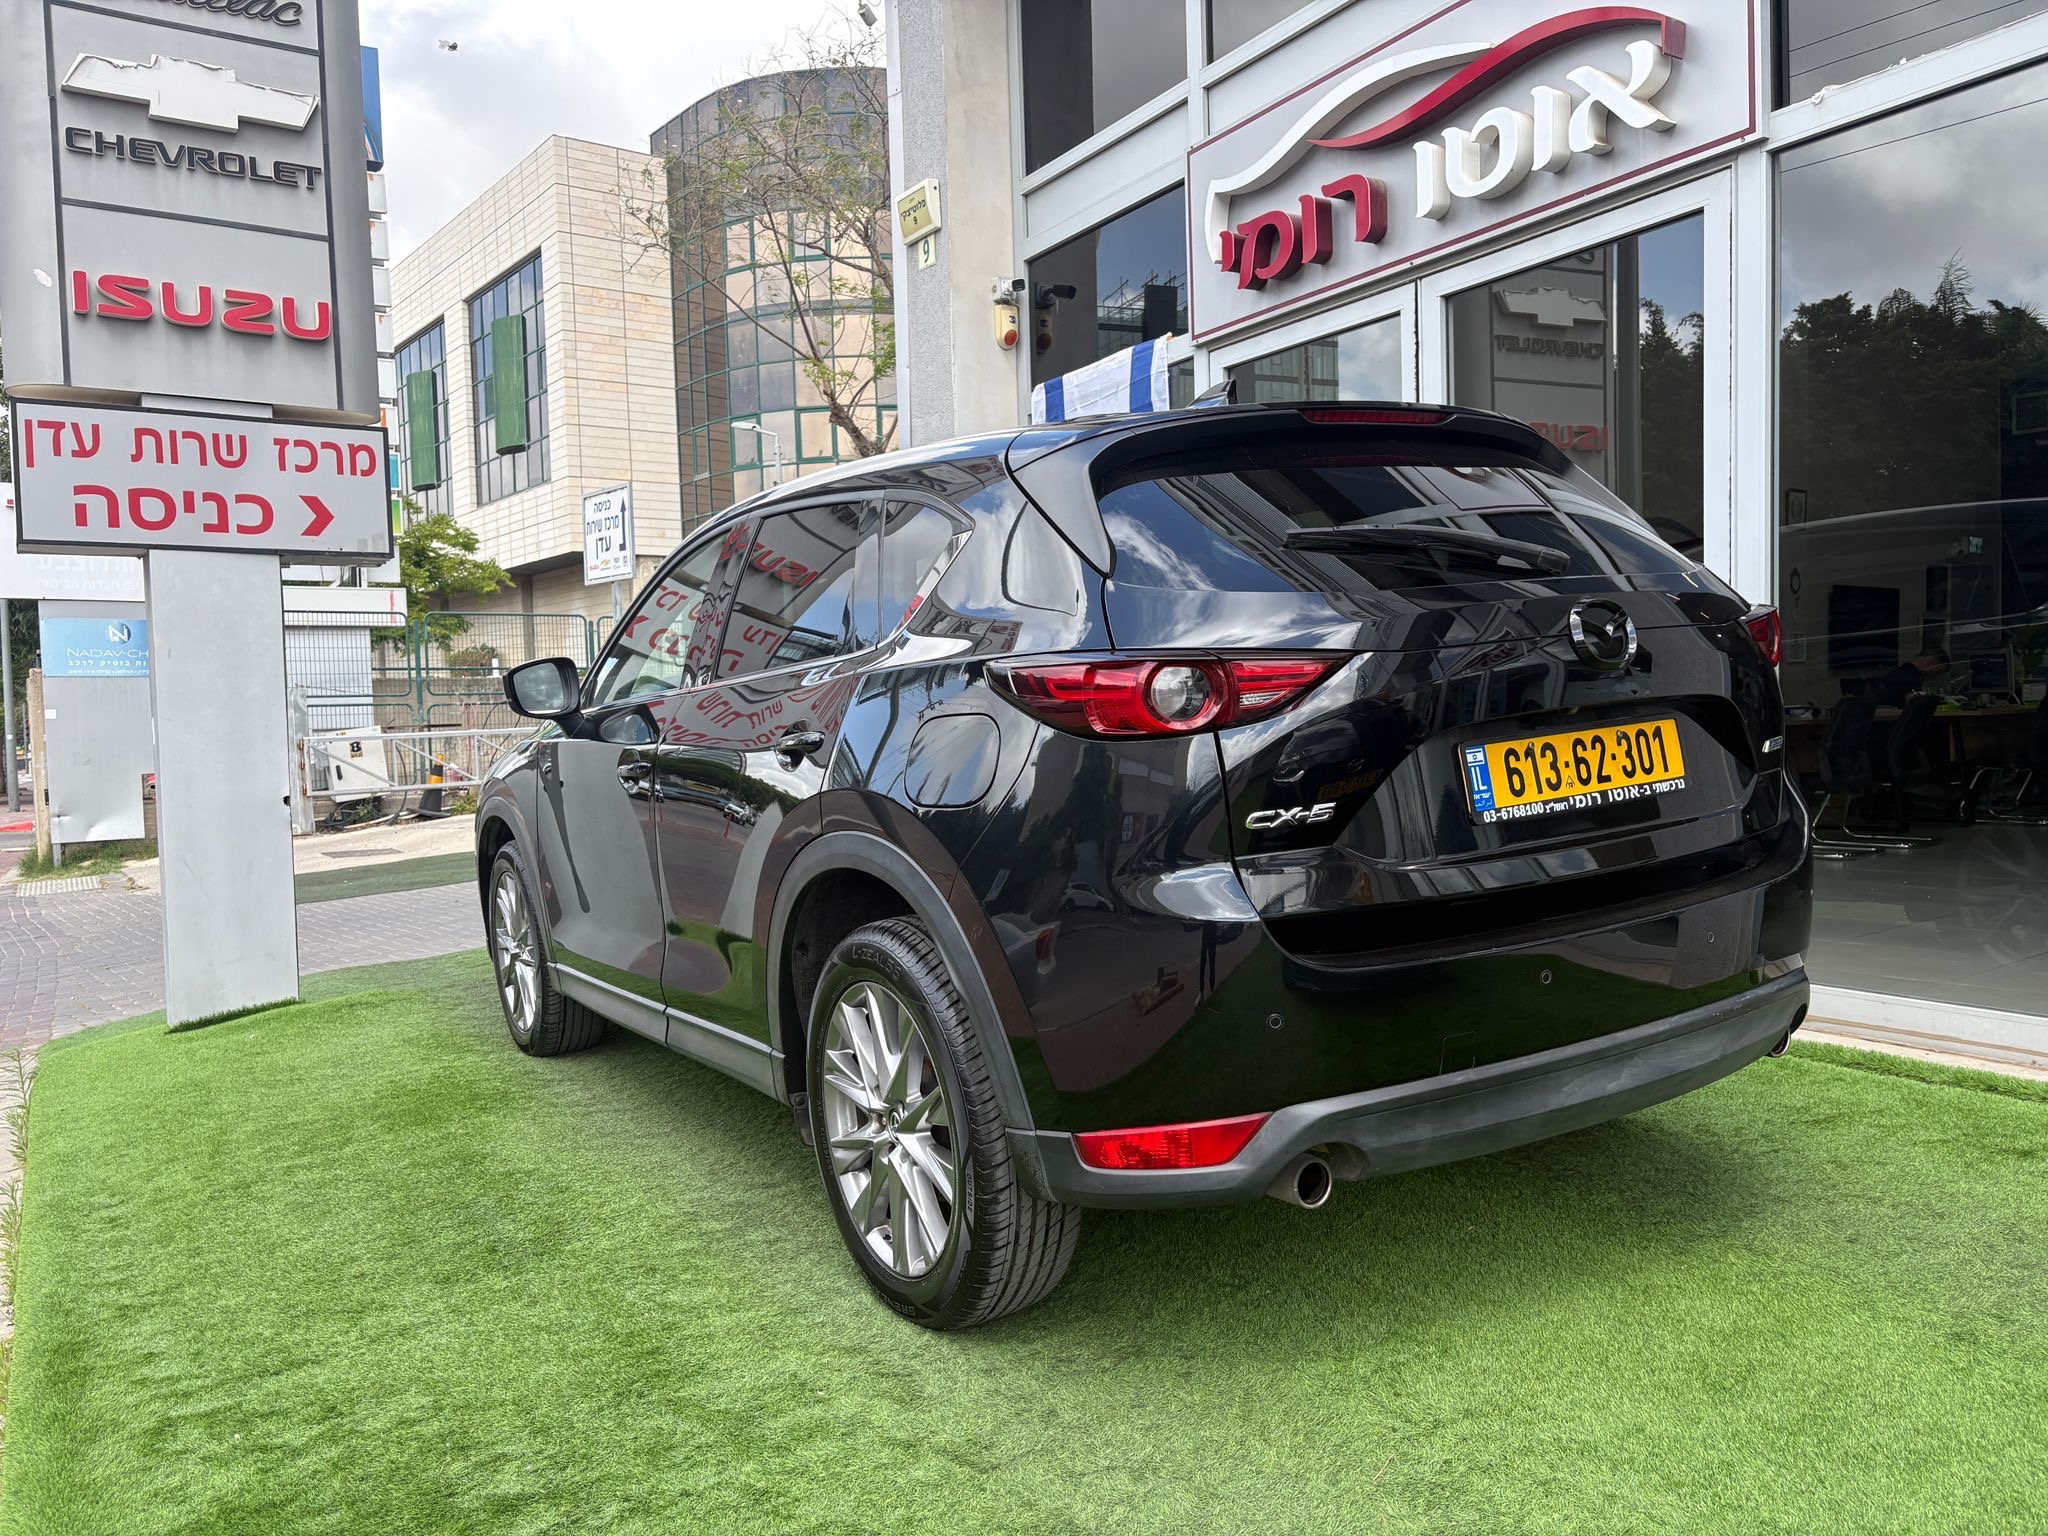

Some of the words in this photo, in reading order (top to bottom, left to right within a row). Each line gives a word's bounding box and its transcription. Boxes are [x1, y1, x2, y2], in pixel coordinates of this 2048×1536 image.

[1412, 39, 1677, 220] אוטו
[64, 126, 322, 189] CHEVROLET
[1219, 173, 1387, 290] רומי
[923, 237, 930, 264] 9
[72, 270, 332, 341] ISUZU
[24, 418, 100, 469] עדן
[130, 426, 248, 469] שרות
[273, 437, 377, 478] מרכז
[72, 483, 275, 536] כניסה
[594, 499, 611, 514] כניסה
[604, 515, 619, 532] מרכז
[595, 535, 612, 560] עדן
[1470, 765, 1488, 792] IL
[1652, 778, 1686, 794] נרכשתי
[1245, 802, 1337, 830] CX-5
[1483, 802, 1544, 823] 03-6768100
[1569, 792, 1602, 809] רומי
[966, 1173, 974, 1214] OUTSIDE
